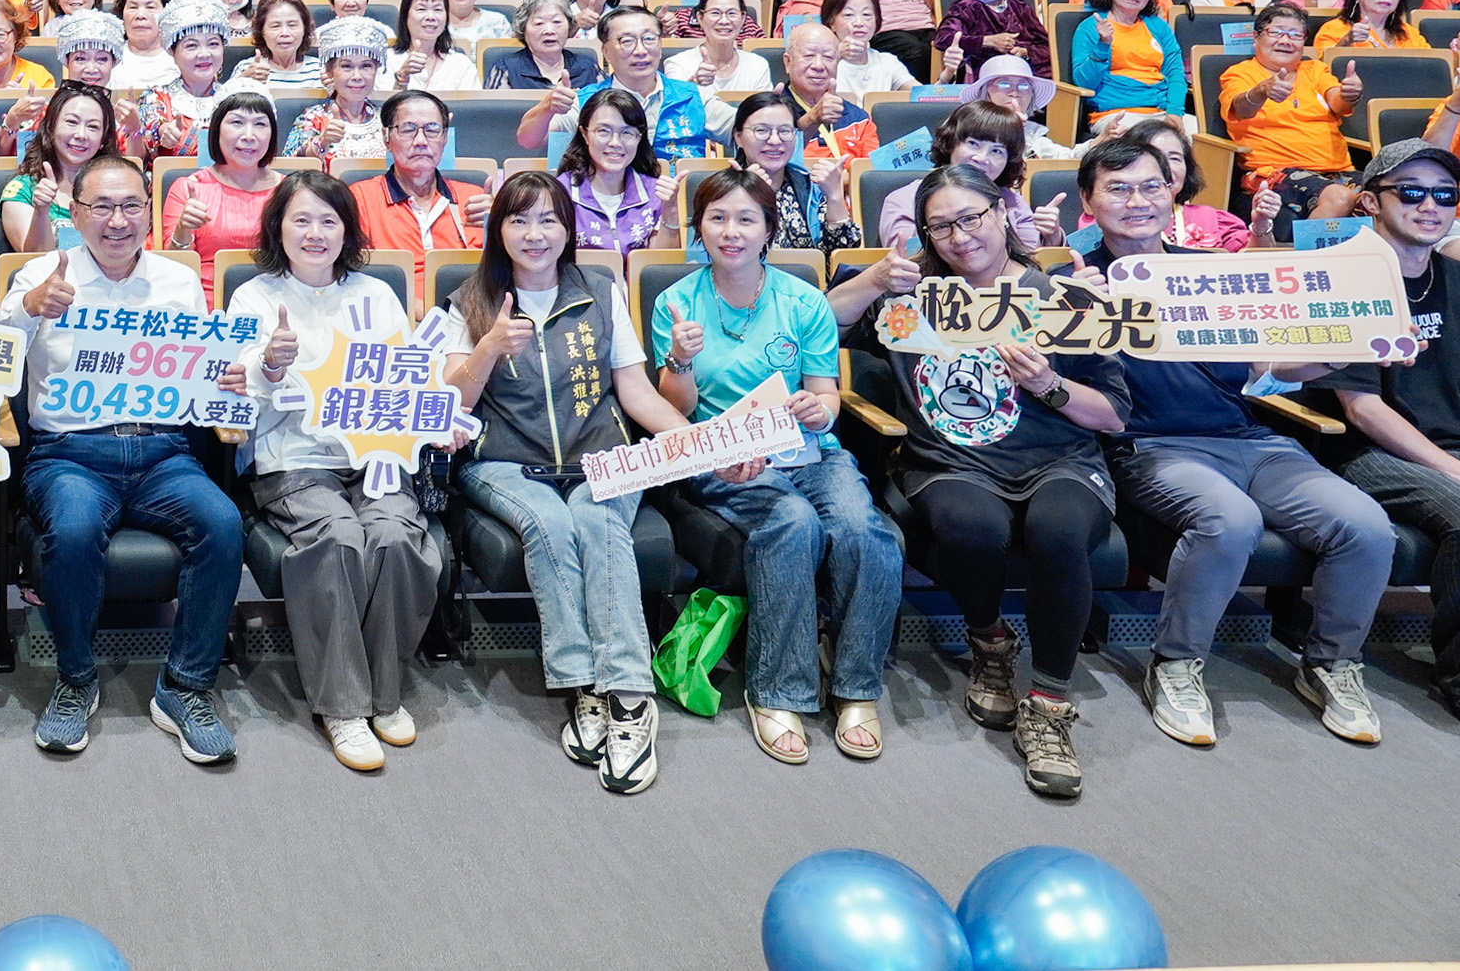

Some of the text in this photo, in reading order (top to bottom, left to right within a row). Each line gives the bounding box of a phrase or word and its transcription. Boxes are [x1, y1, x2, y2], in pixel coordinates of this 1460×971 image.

[54, 306, 258, 344] 115年松年大學
[920, 282, 1155, 349] 松大之光
[1217, 304, 1300, 321] 多元文化
[565, 332, 582, 359] 里長
[577, 320, 597, 362] 板橋區
[1176, 324, 1353, 346] 健康運動 文創藝能
[345, 342, 433, 384] 閃亮
[42, 378, 255, 425] 30,439人受益
[322, 387, 455, 432] 銀髮團
[570, 364, 591, 418] 洪雅鈴
[586, 405, 796, 482] 新北市政府社會局
[593, 485, 618, 499] Social
[618, 478, 648, 493] Welfare
[713, 455, 738, 468] Taipei
[737, 449, 753, 461] City
[754, 438, 802, 455] Government
